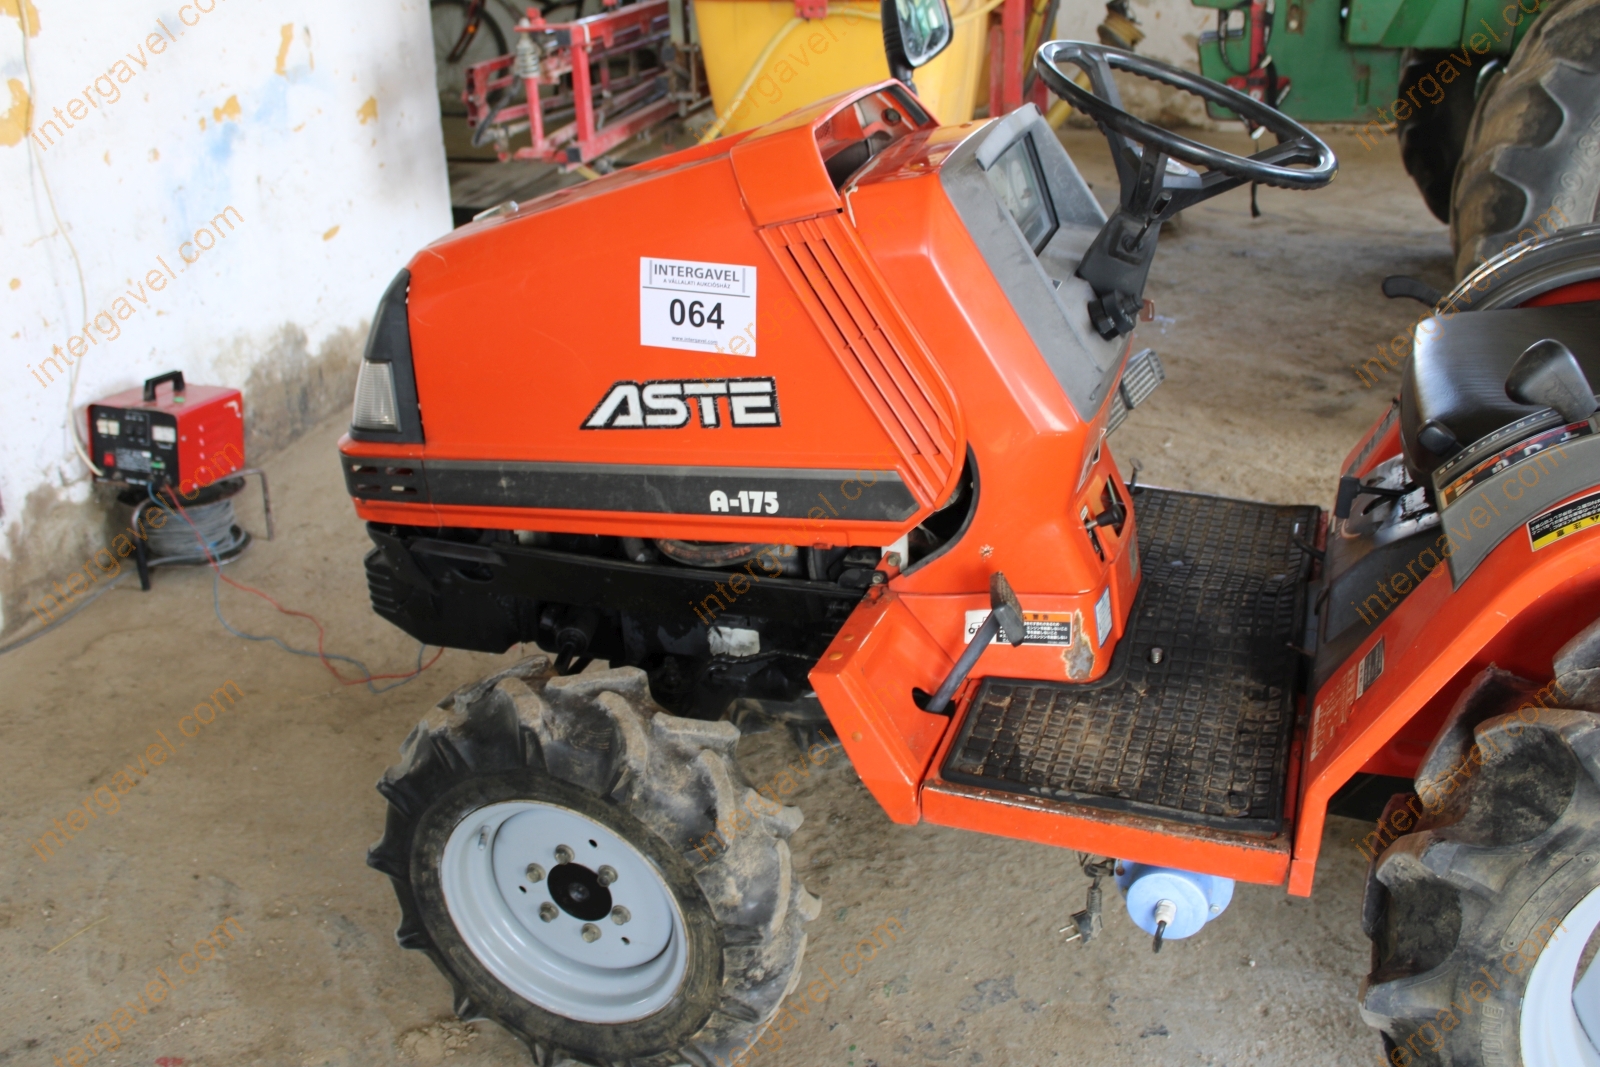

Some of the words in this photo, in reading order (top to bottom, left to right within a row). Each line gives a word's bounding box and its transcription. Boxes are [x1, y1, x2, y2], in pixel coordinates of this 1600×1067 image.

[654, 263, 740, 282] INTERGAVEL
[669, 298, 725, 330] 064
[671, 335, 719, 346] www.intergavel.com
[581, 376, 781, 430] ASTE
[709, 490, 779, 514] A-175
